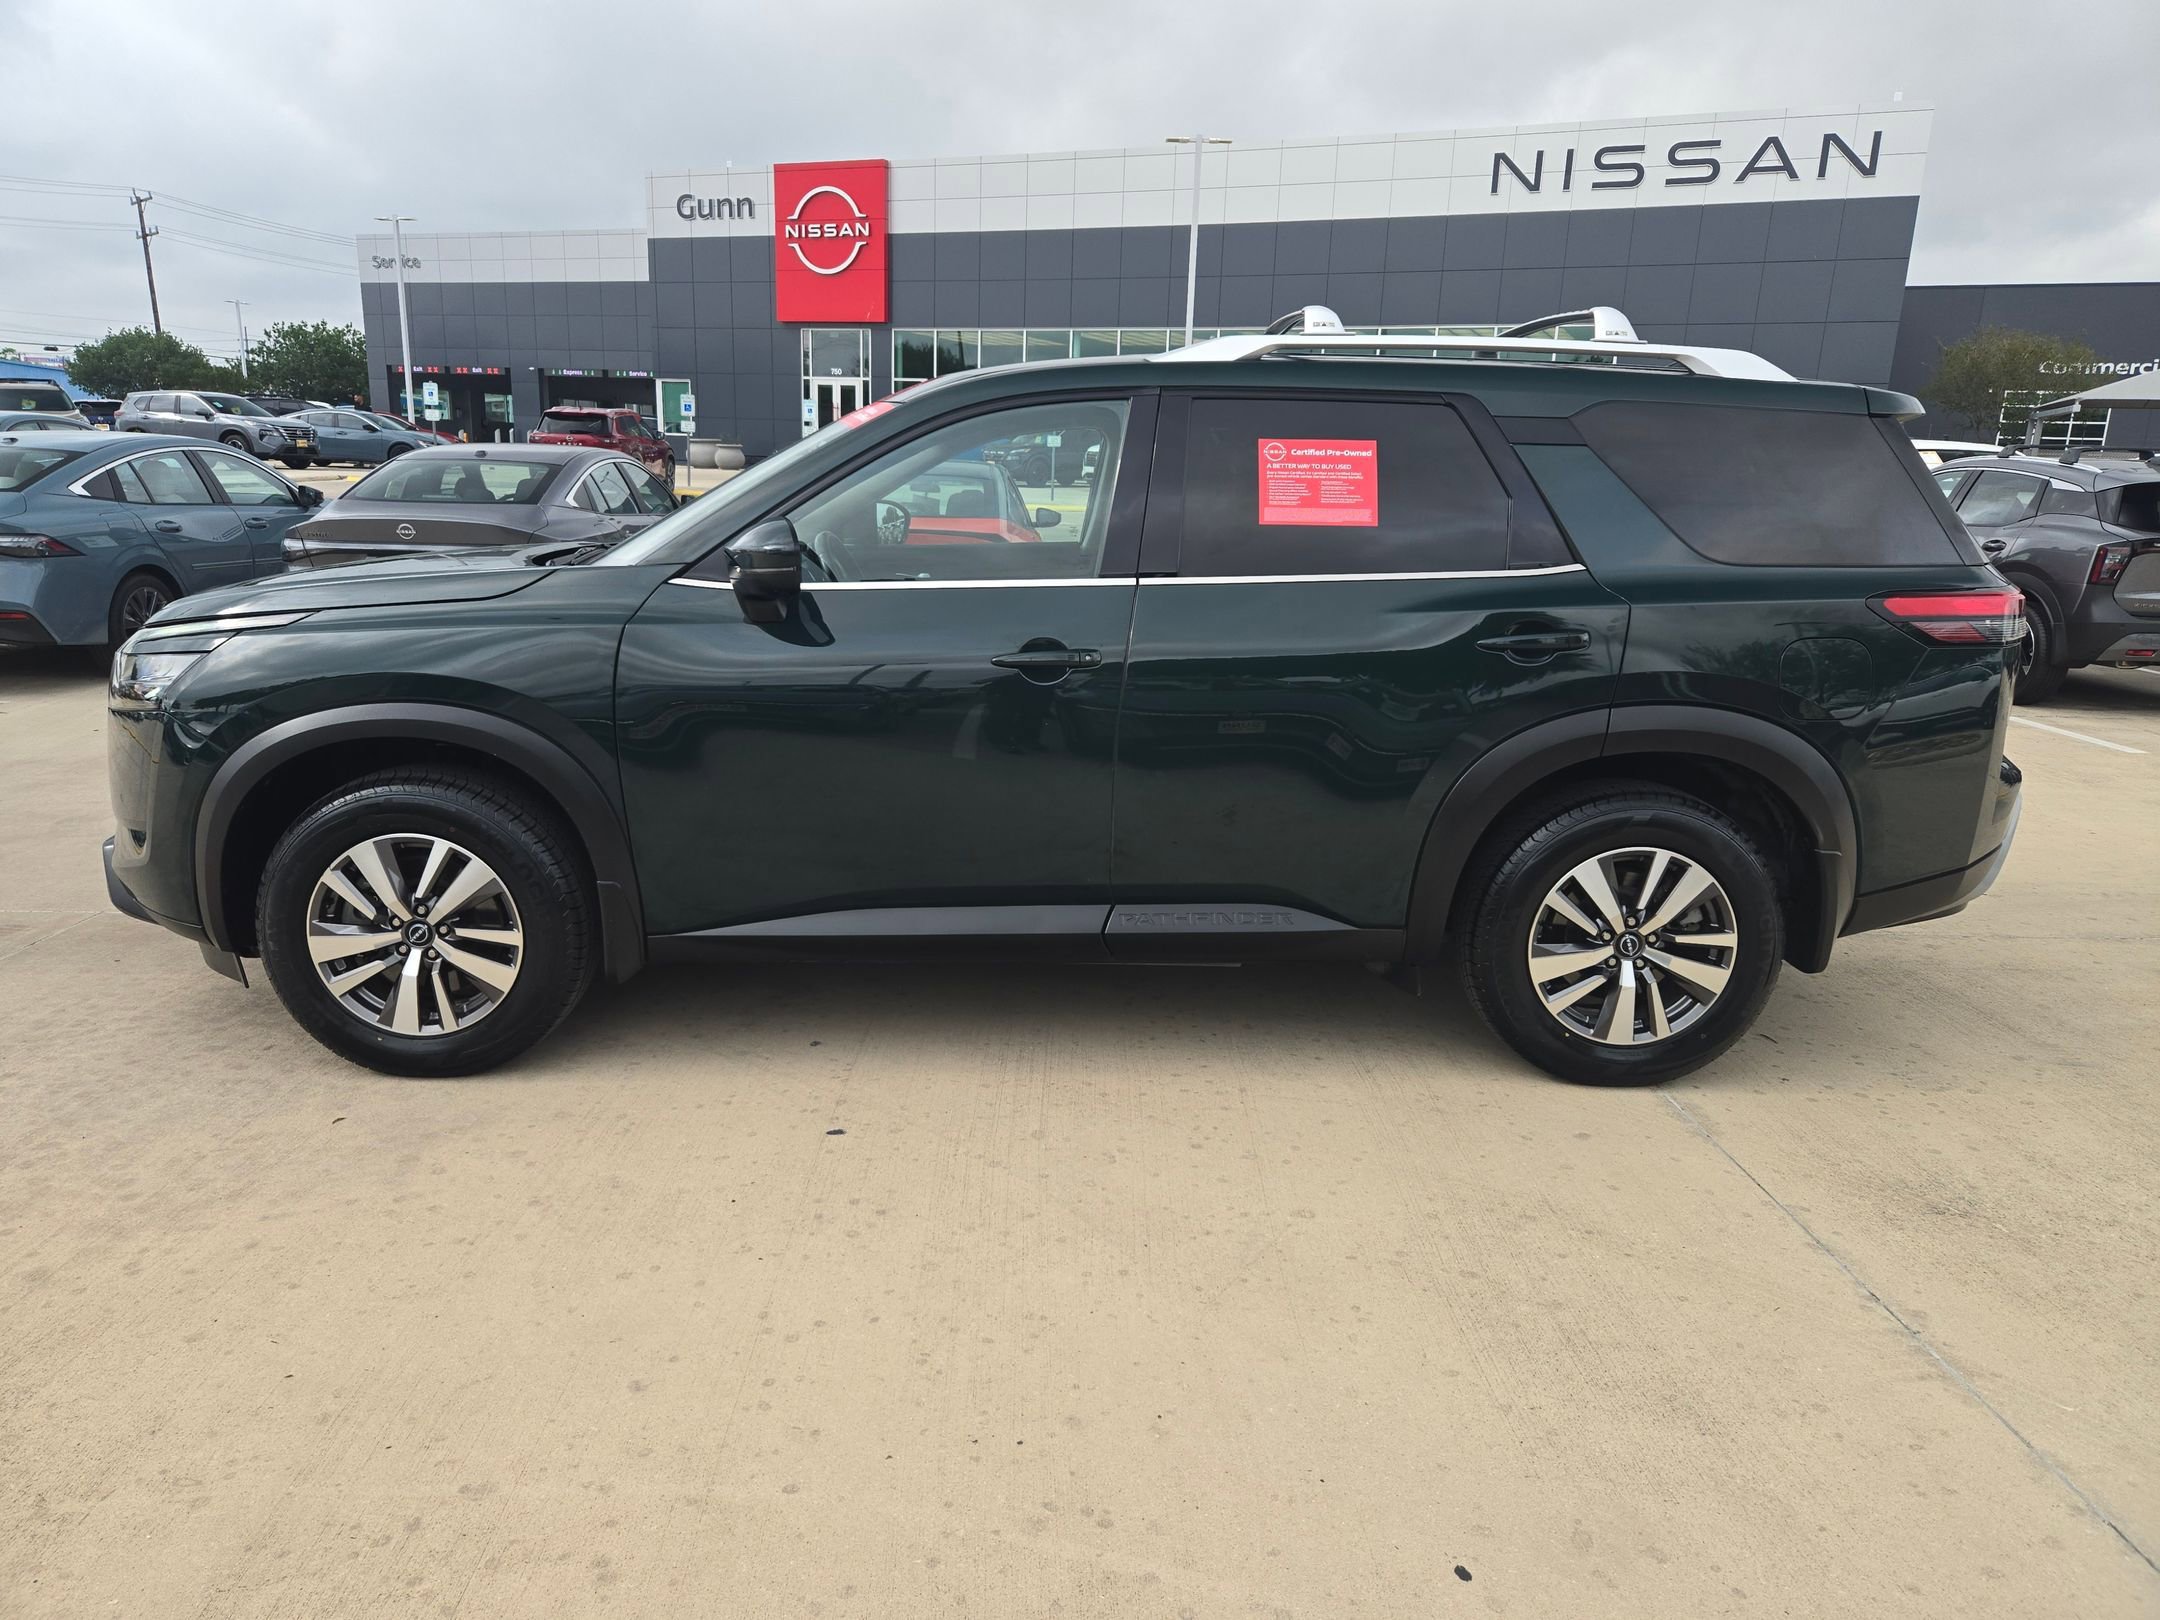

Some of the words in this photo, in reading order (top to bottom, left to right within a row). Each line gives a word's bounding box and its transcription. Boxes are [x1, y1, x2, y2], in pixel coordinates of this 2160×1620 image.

[1490, 130, 1883, 196] NISSAN
[676, 193, 755, 220] Gunn
[785, 222, 870, 239] NISSAN
[371, 254, 421, 269] Serice
[1291, 448, 1325, 456] Certified
[1327, 449, 1372, 457] Pre-Owned
[1118, 911, 1295, 926] PATHFINDER
